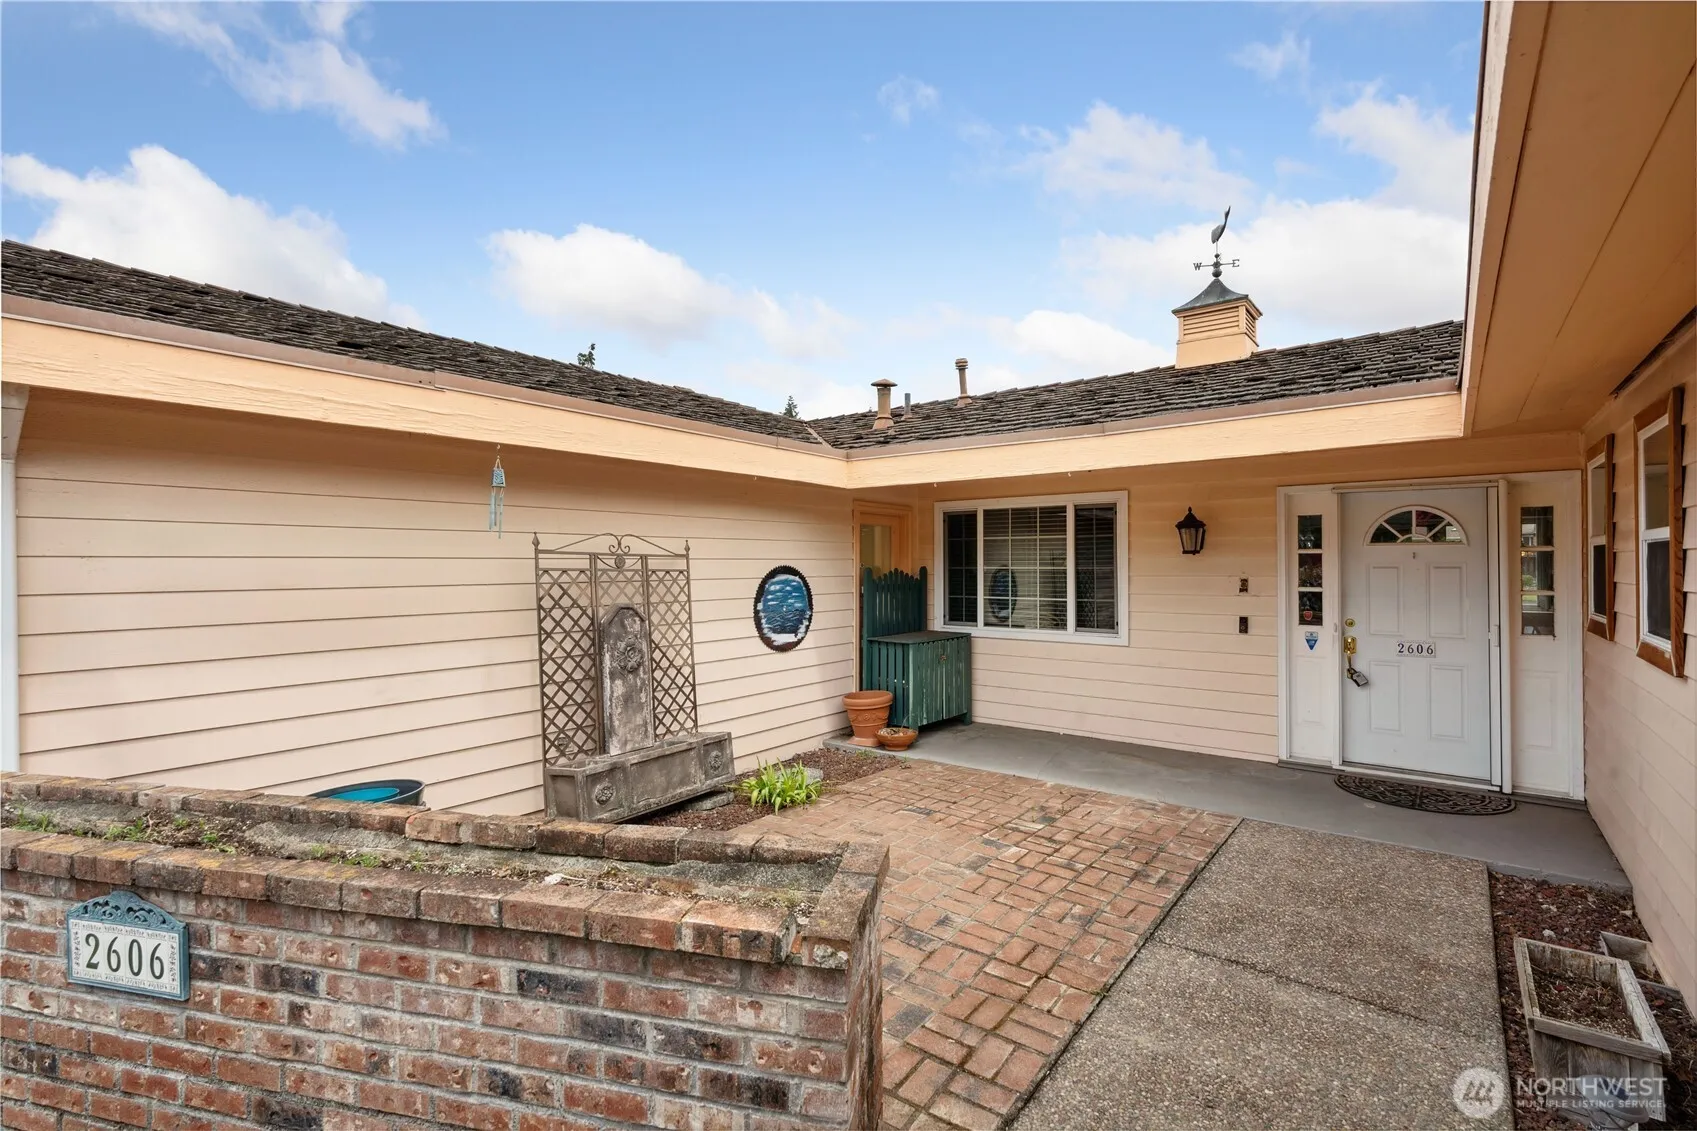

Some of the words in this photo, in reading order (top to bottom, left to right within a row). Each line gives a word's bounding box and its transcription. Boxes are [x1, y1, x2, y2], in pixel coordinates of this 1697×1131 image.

[1193, 262, 1202, 271] W
[1232, 259, 1240, 267] E
[1397, 642, 1434, 655] 2606
[84, 933, 165, 980] 2606
